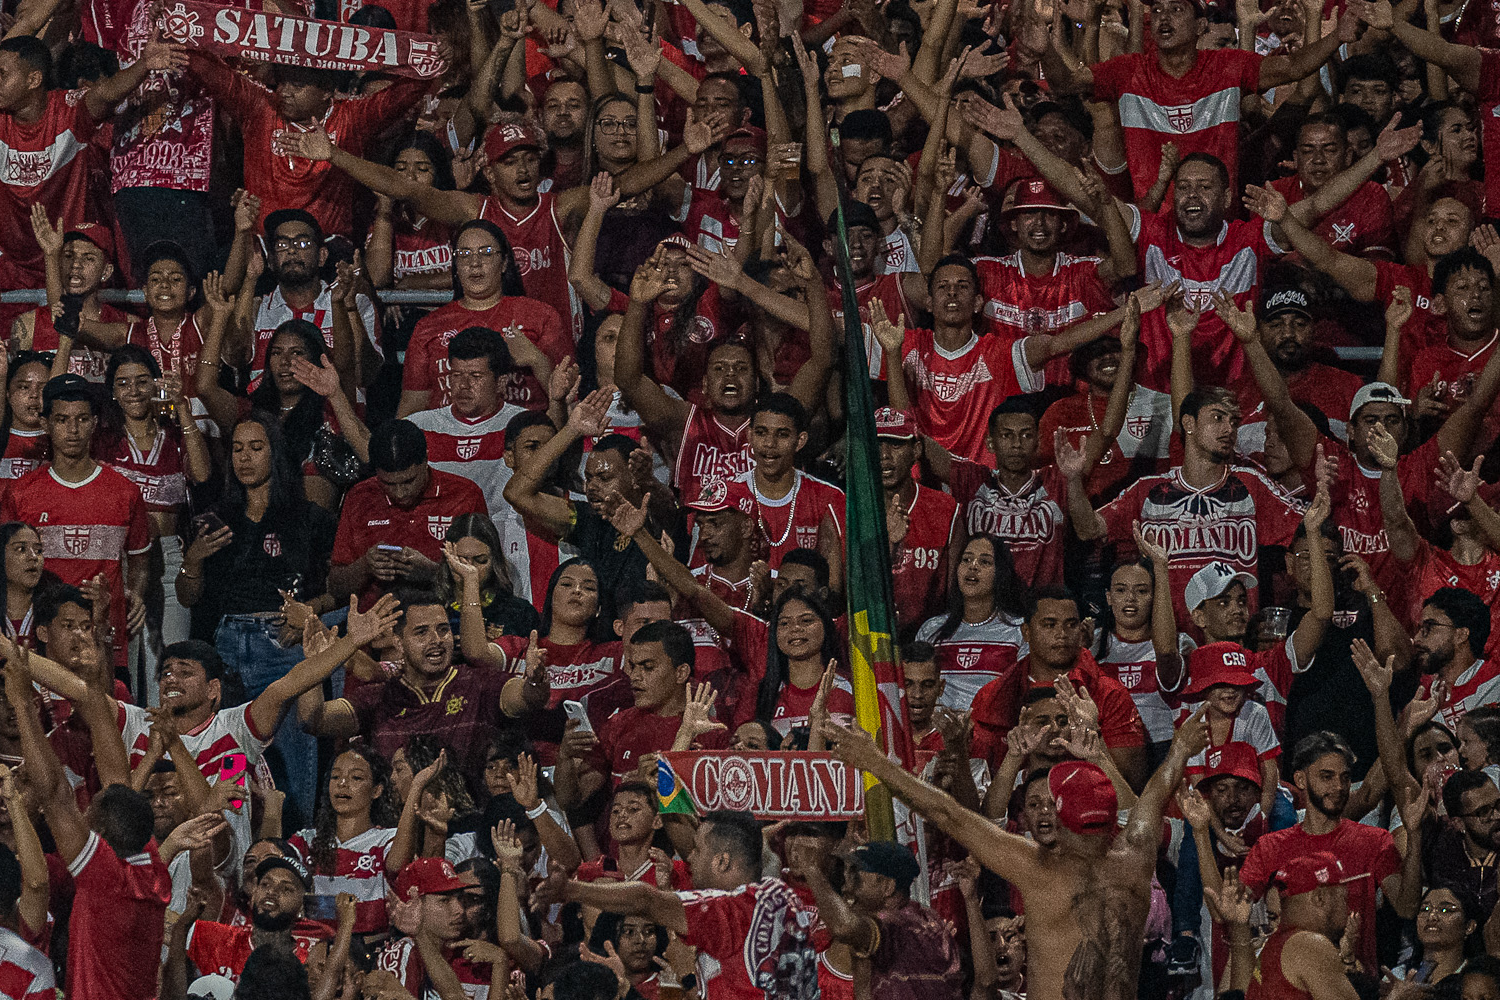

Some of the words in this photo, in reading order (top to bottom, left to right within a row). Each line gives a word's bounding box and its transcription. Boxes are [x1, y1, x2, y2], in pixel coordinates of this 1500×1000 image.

[214, 8, 399, 66] SATUBA
[274, 52, 300, 66] ATÉ
[303, 57, 313, 68] A
[396, 247, 454, 277] MAND
[1141, 518, 1257, 561] COMANDO
[914, 547, 940, 570] 93
[1223, 652, 1248, 667] CRB
